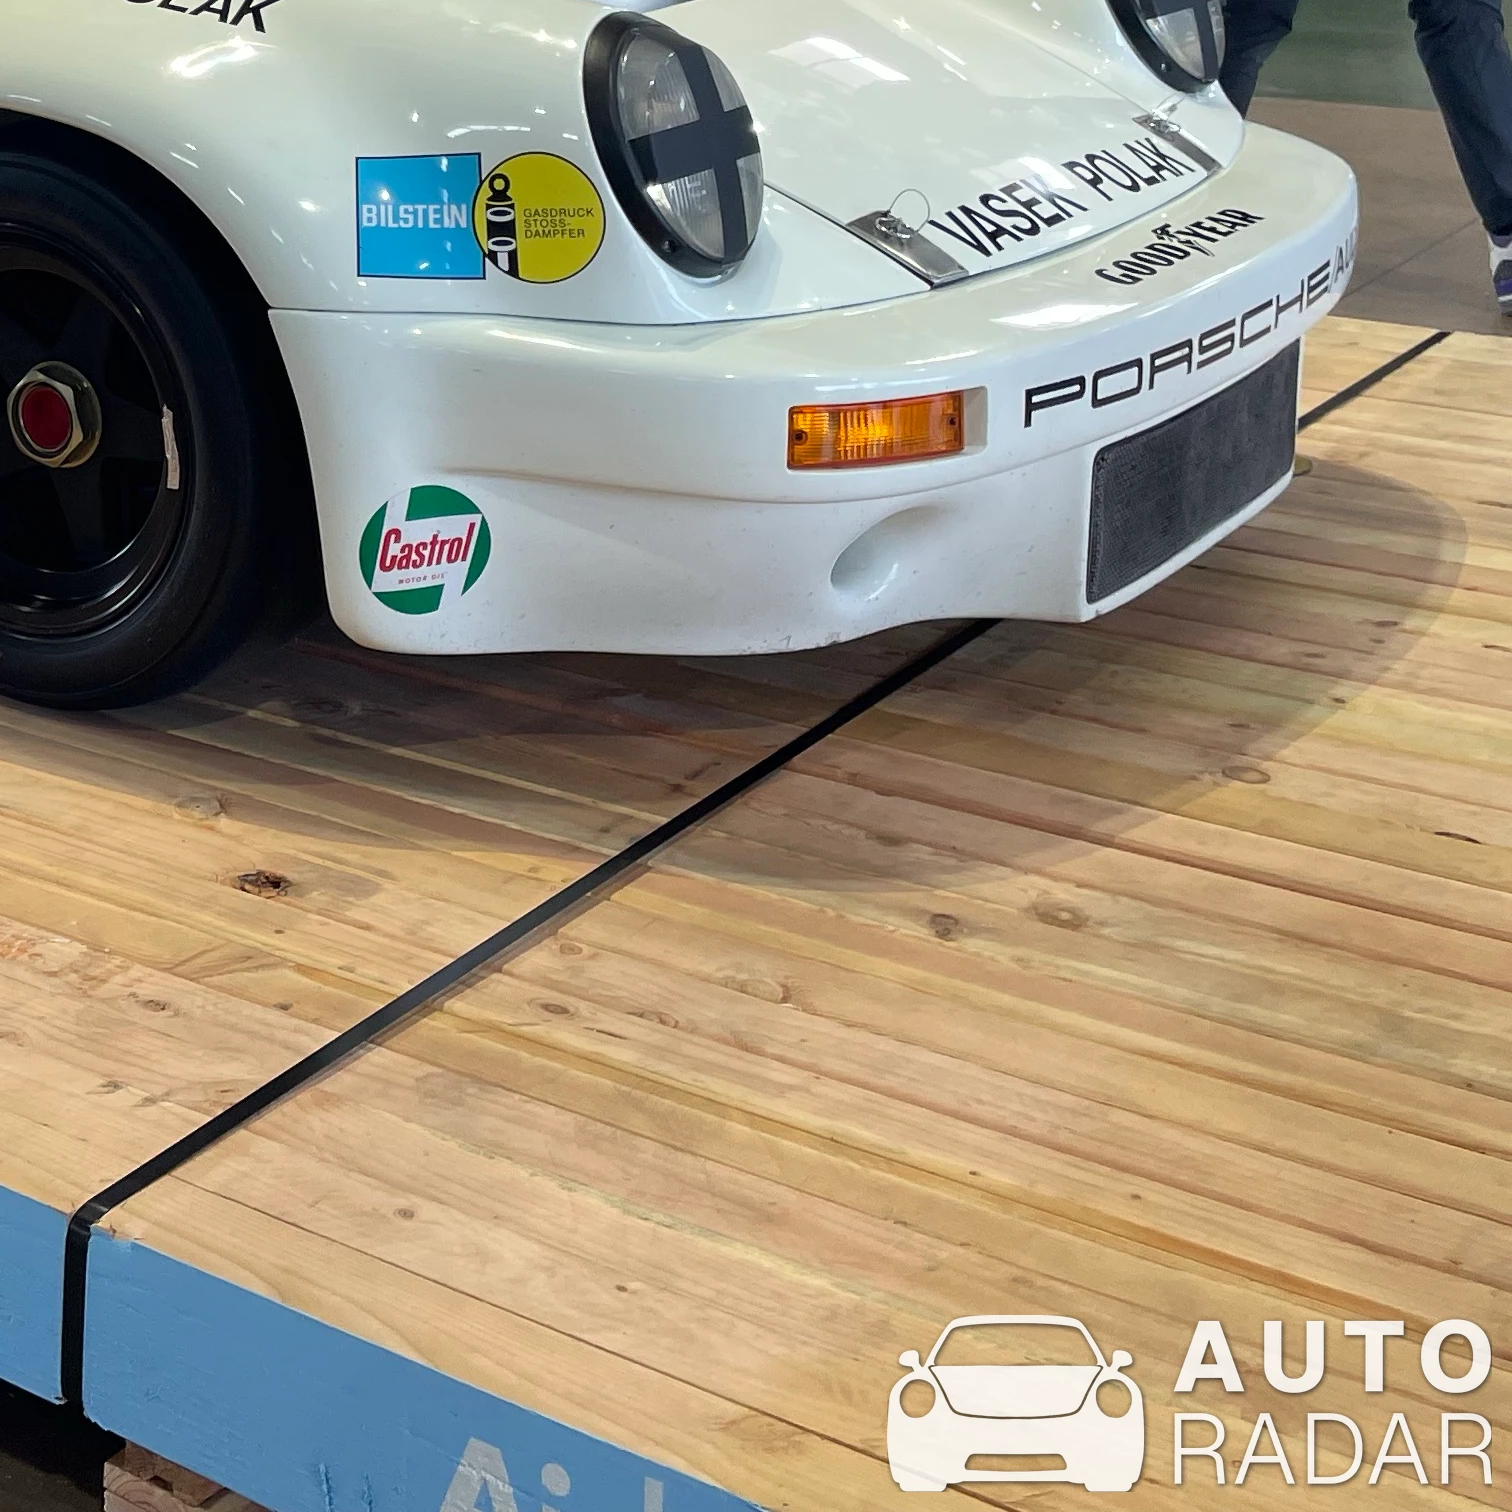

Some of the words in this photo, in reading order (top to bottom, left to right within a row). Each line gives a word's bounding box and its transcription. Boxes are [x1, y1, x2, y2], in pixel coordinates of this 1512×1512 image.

[361, 203, 468, 229] BILSTEIN
[523, 207, 595, 218] GASDRUCK
[927, 175, 1090, 258] VASEK
[1060, 137, 1196, 202] POLAK
[523, 219, 572, 229] STOSS-
[1094, 208, 1266, 286] GOODYEAR
[379, 521, 477, 573] Castrol
